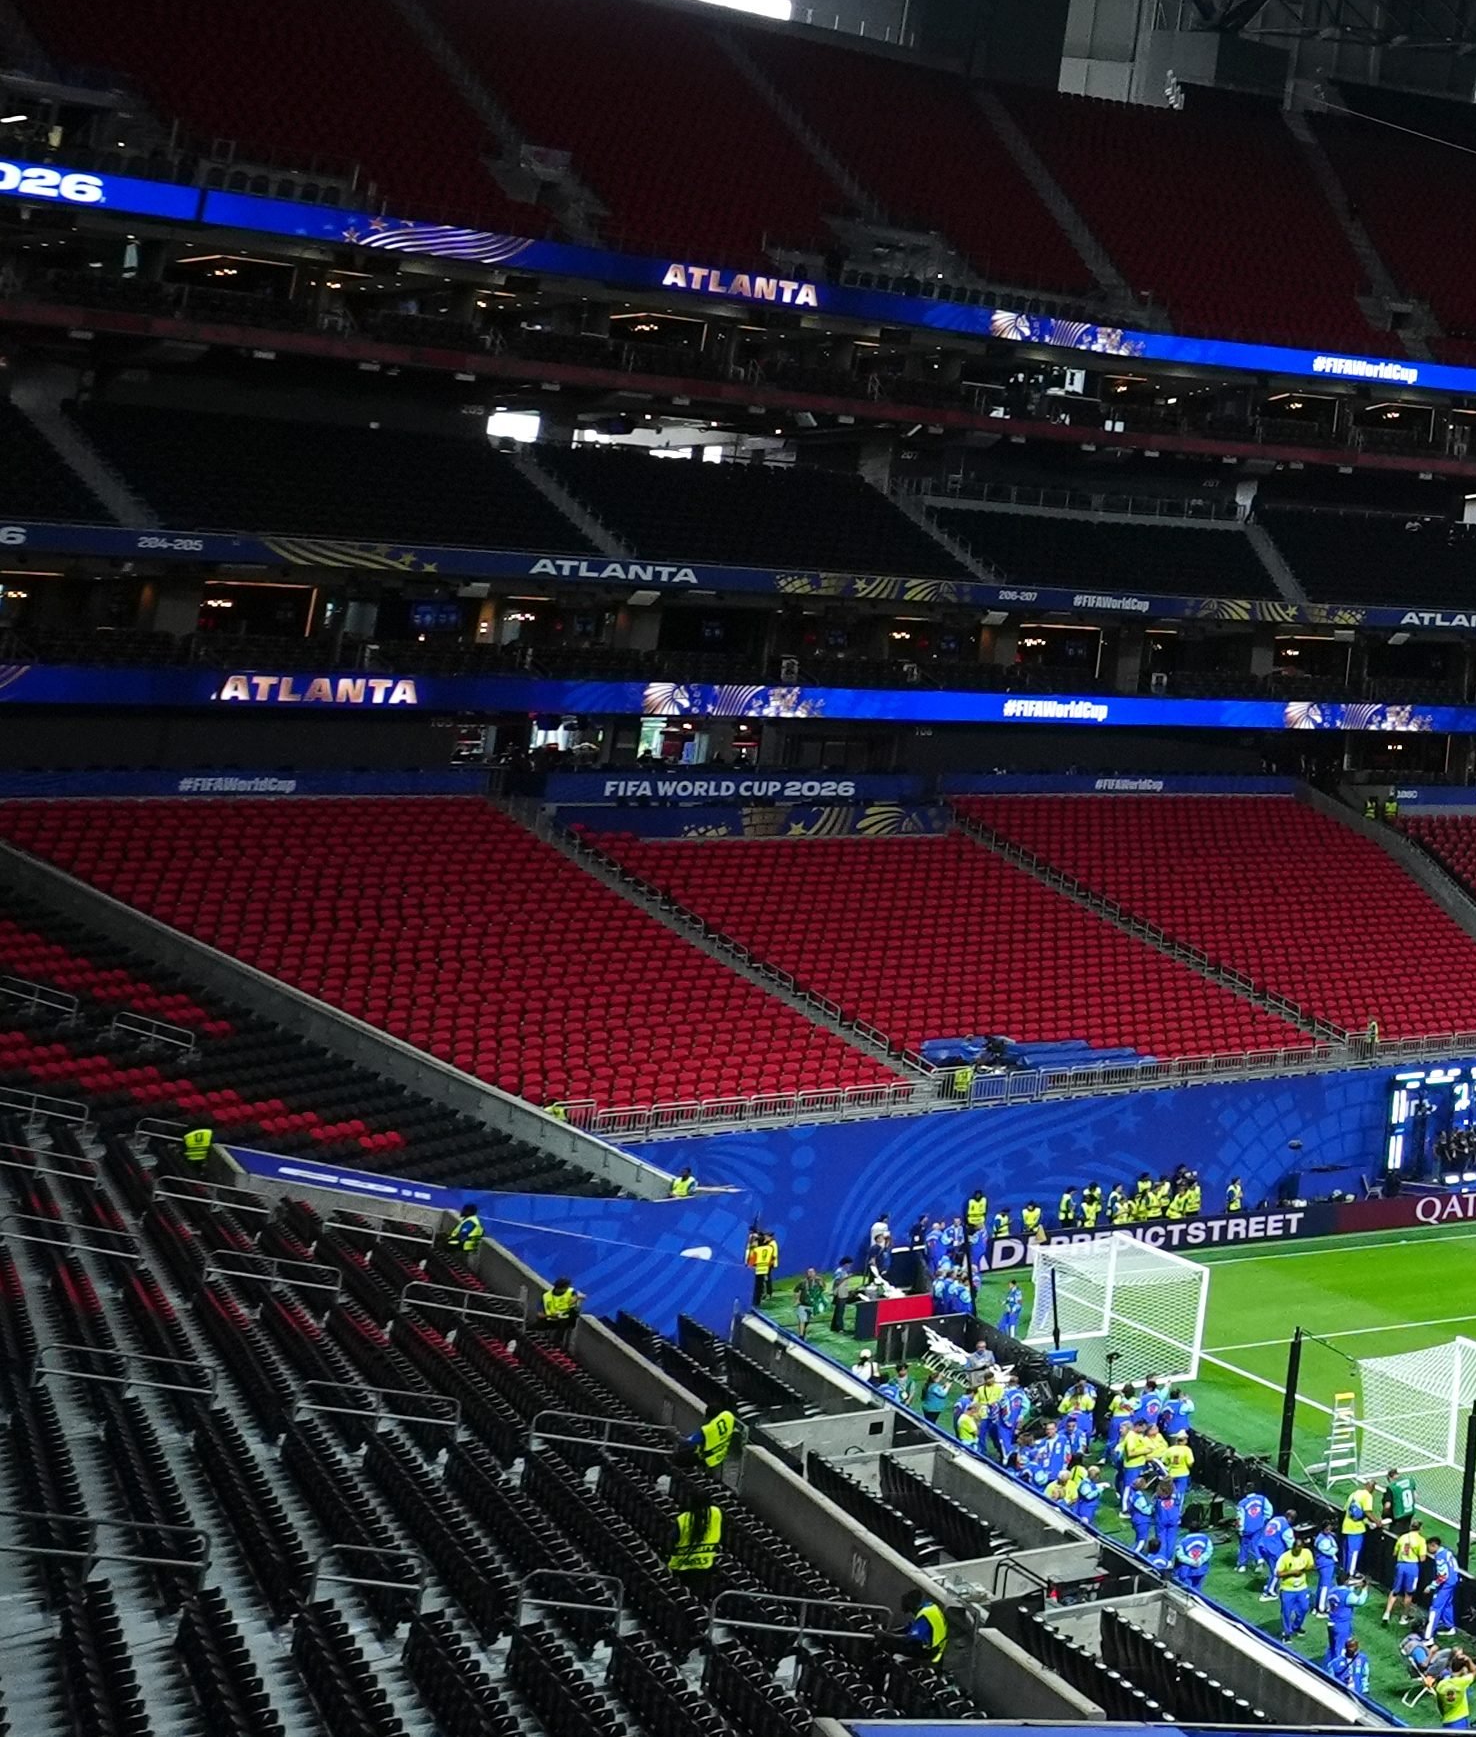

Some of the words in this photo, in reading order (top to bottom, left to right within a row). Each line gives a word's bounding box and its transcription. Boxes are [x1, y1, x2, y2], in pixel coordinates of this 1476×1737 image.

[662, 263, 818, 307] ATLANTA
[1313, 356, 1418, 384] #FIFAWorldCup
[529, 557, 698, 584] ATLANTA
[1073, 593, 1150, 613] #FIFAWorldCup
[220, 675, 418, 704] ATLANTA
[1002, 700, 1108, 722] #FIFAWorldCup
[178, 776, 296, 794] #FIFAWorldCup
[604, 780, 652, 796] FIFA
[657, 780, 736, 797] WORLD
[738, 780, 782, 797] CUP
[784, 780, 856, 798] 2026
